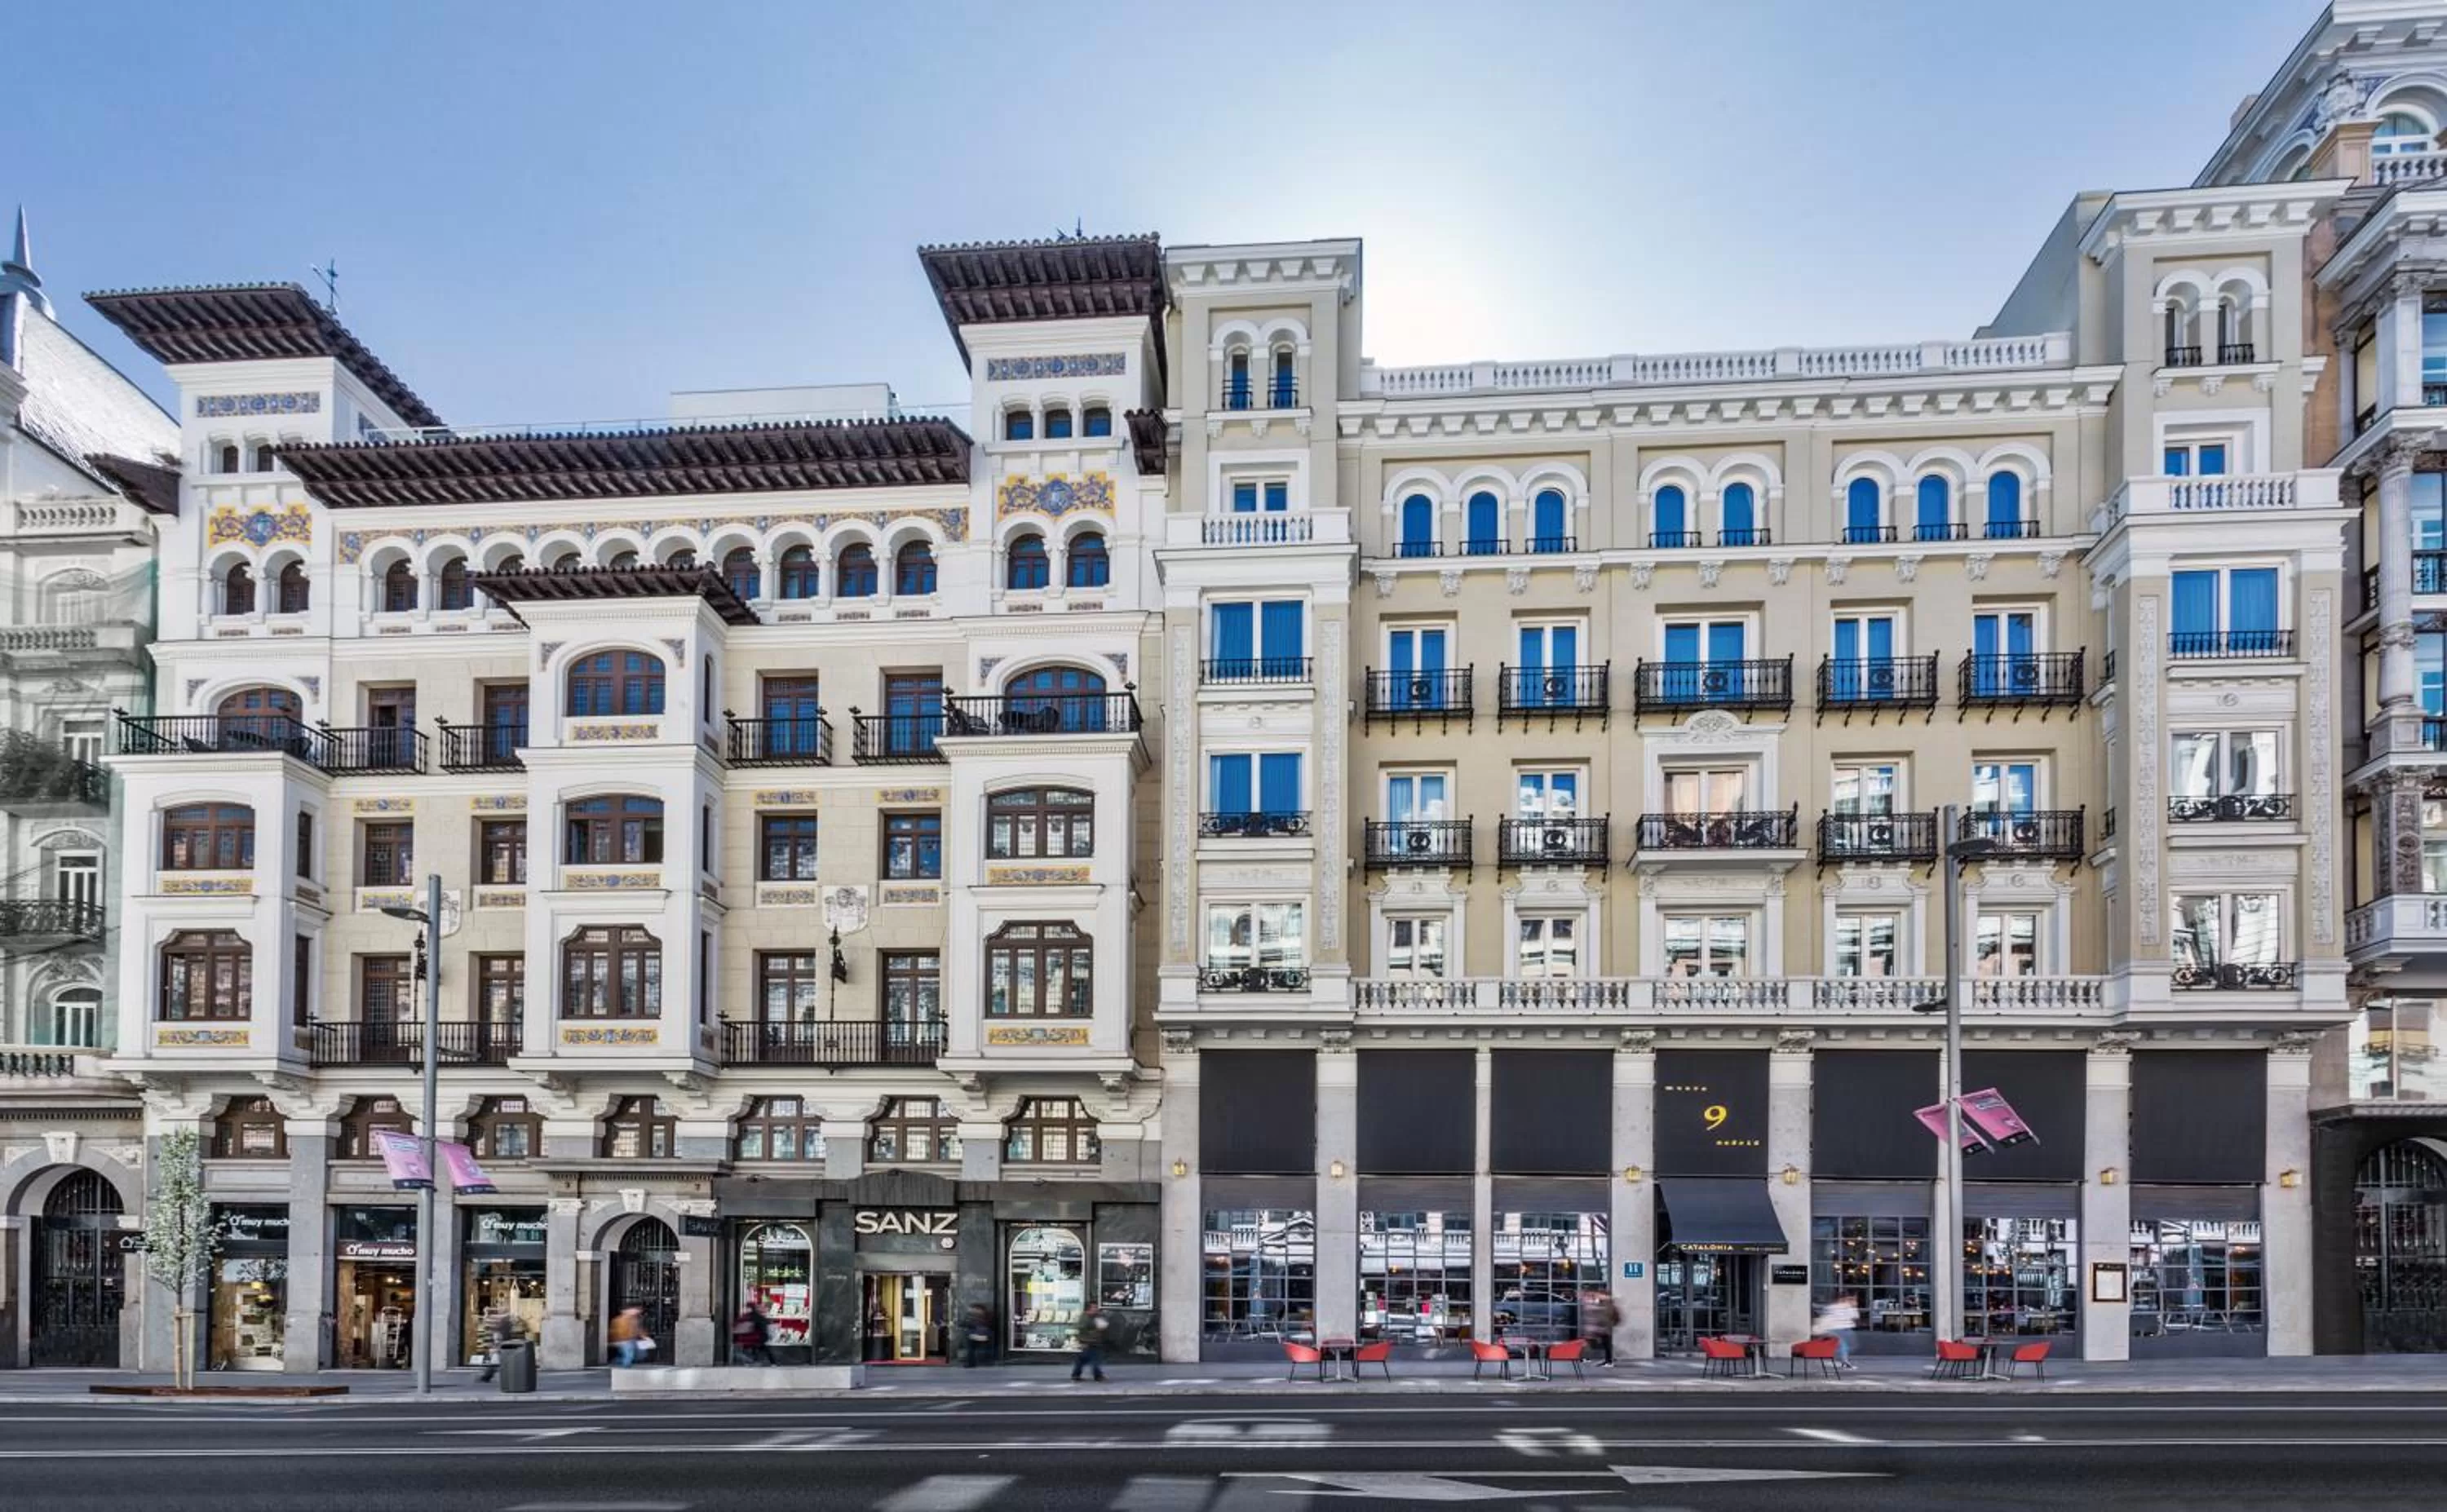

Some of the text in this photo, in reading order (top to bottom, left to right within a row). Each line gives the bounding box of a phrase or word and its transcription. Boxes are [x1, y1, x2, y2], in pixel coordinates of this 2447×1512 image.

[1704, 1105, 1727, 1131] 9
[264, 1218, 290, 1226] much
[854, 1211, 958, 1234] SANZ
[358, 1246, 414, 1256] muy mucho
